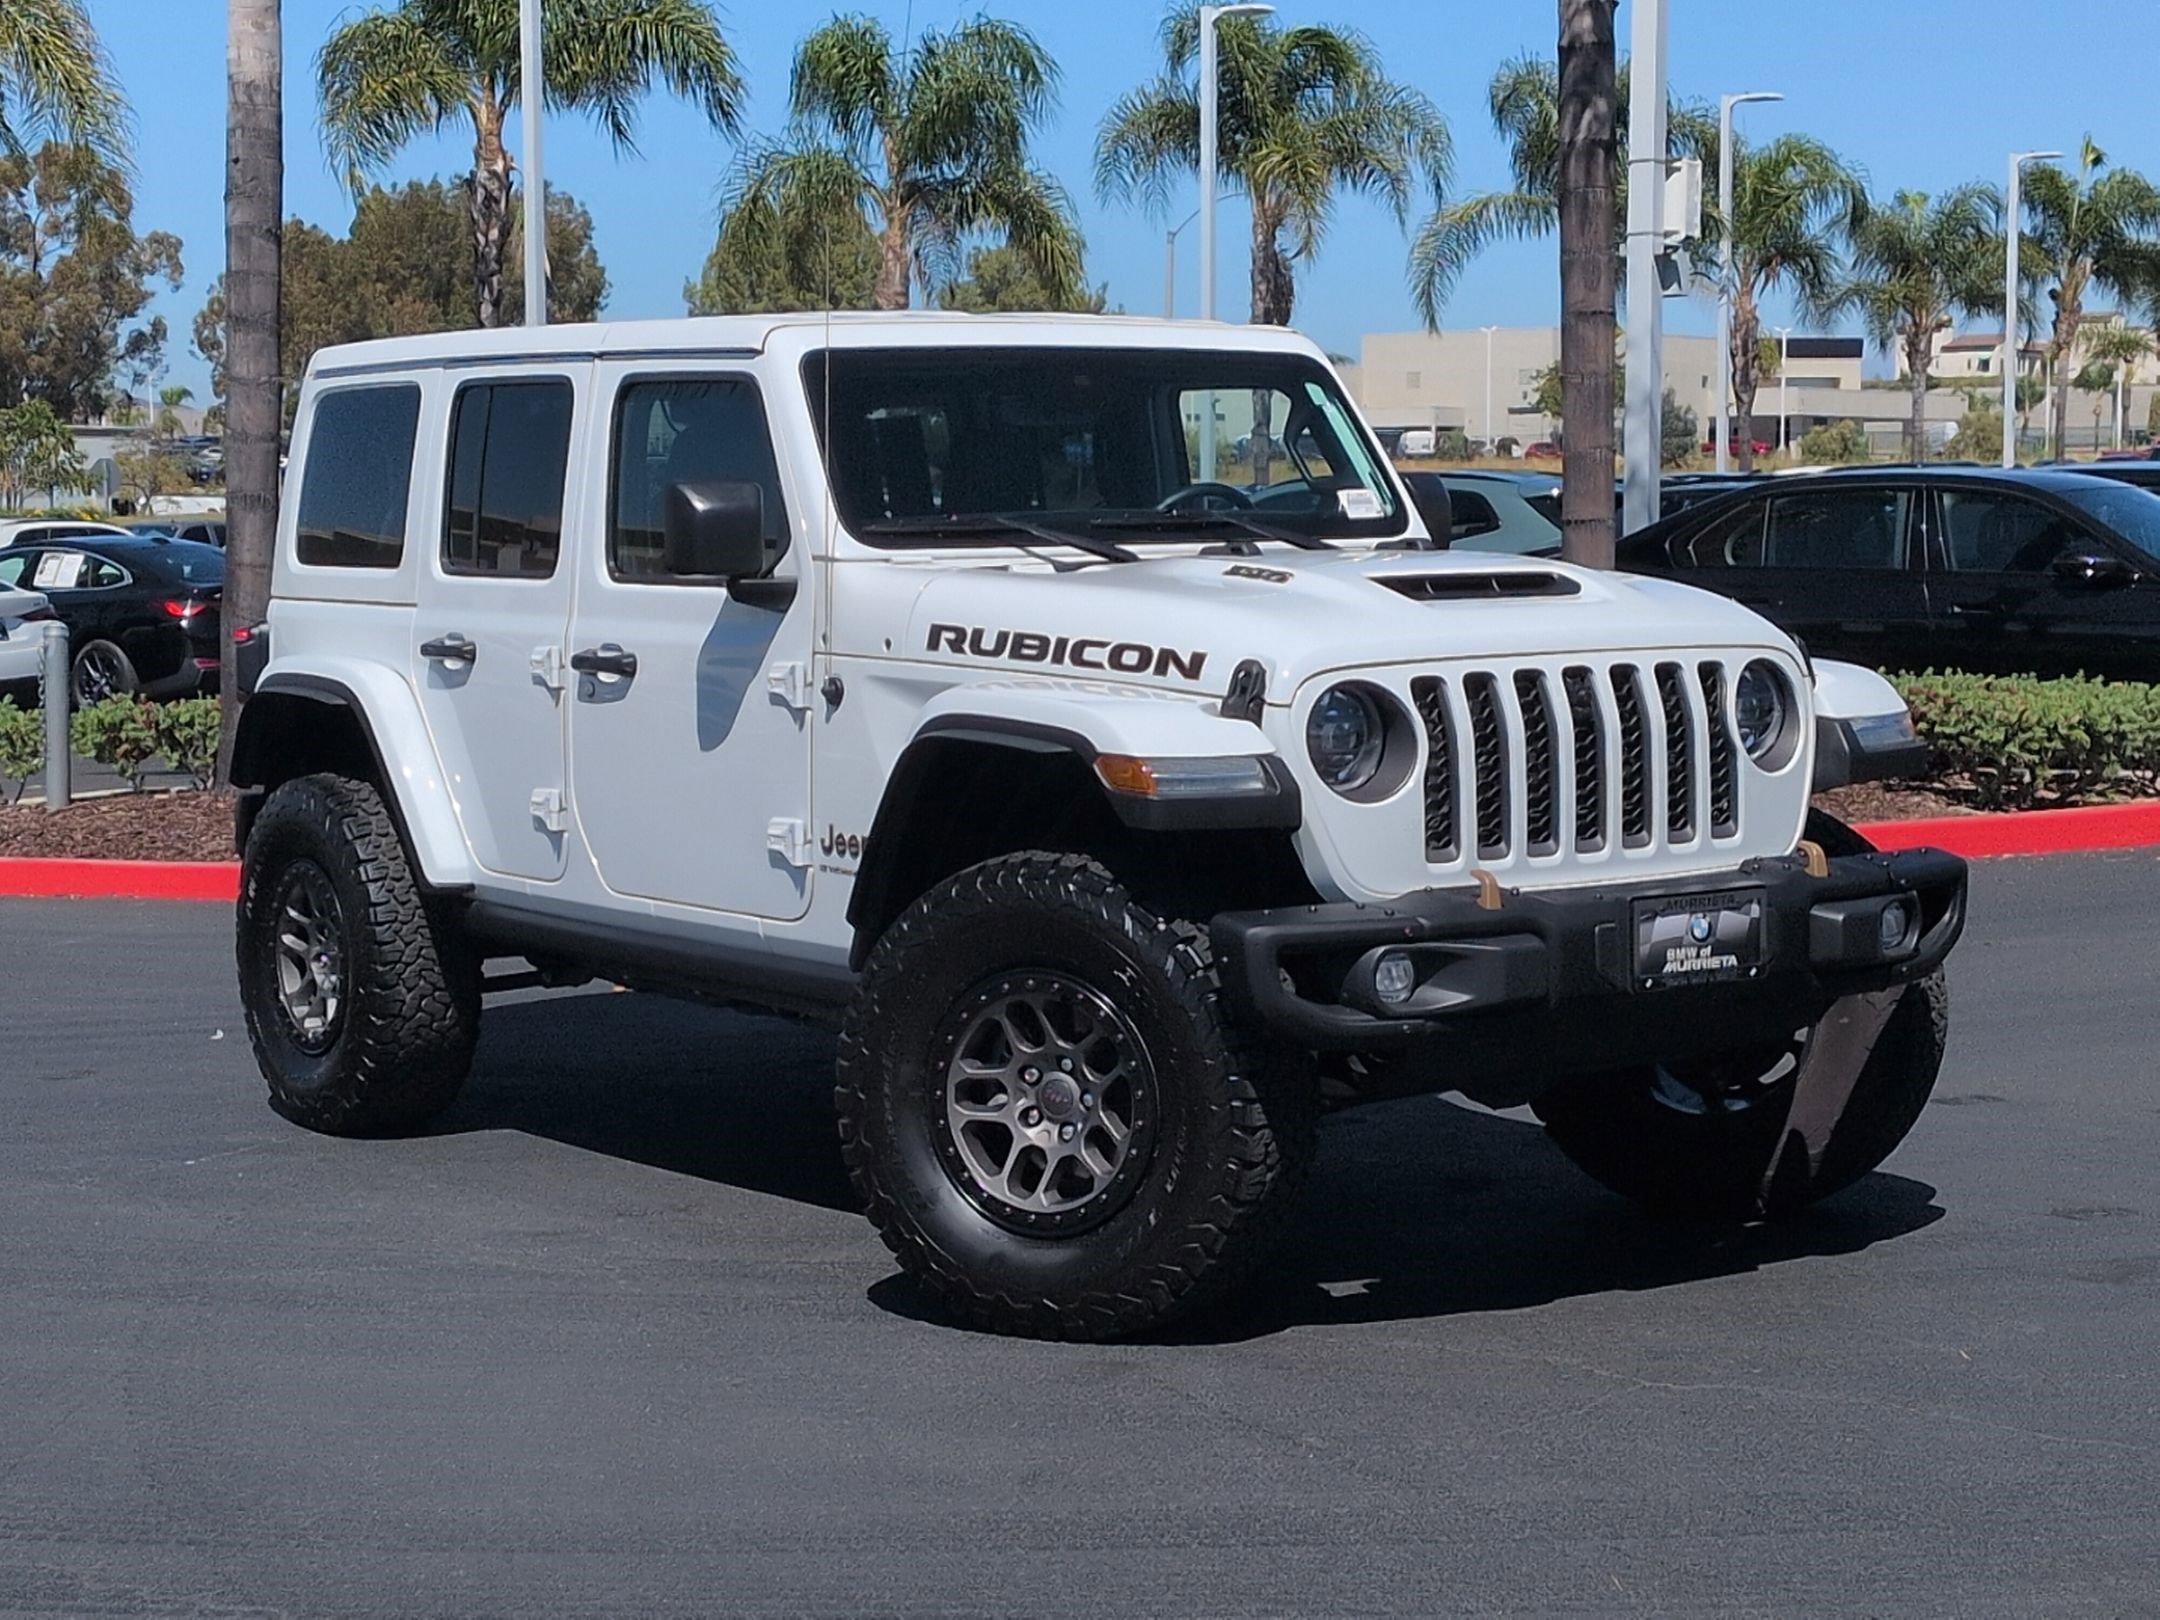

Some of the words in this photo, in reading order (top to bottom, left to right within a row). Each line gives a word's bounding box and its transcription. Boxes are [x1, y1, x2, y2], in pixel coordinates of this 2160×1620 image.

[925, 622, 1209, 681] RUBICON
[820, 823, 866, 860] Jee
[1662, 954, 1739, 974] MURRIETA
[1666, 947, 1697, 961] BMW
